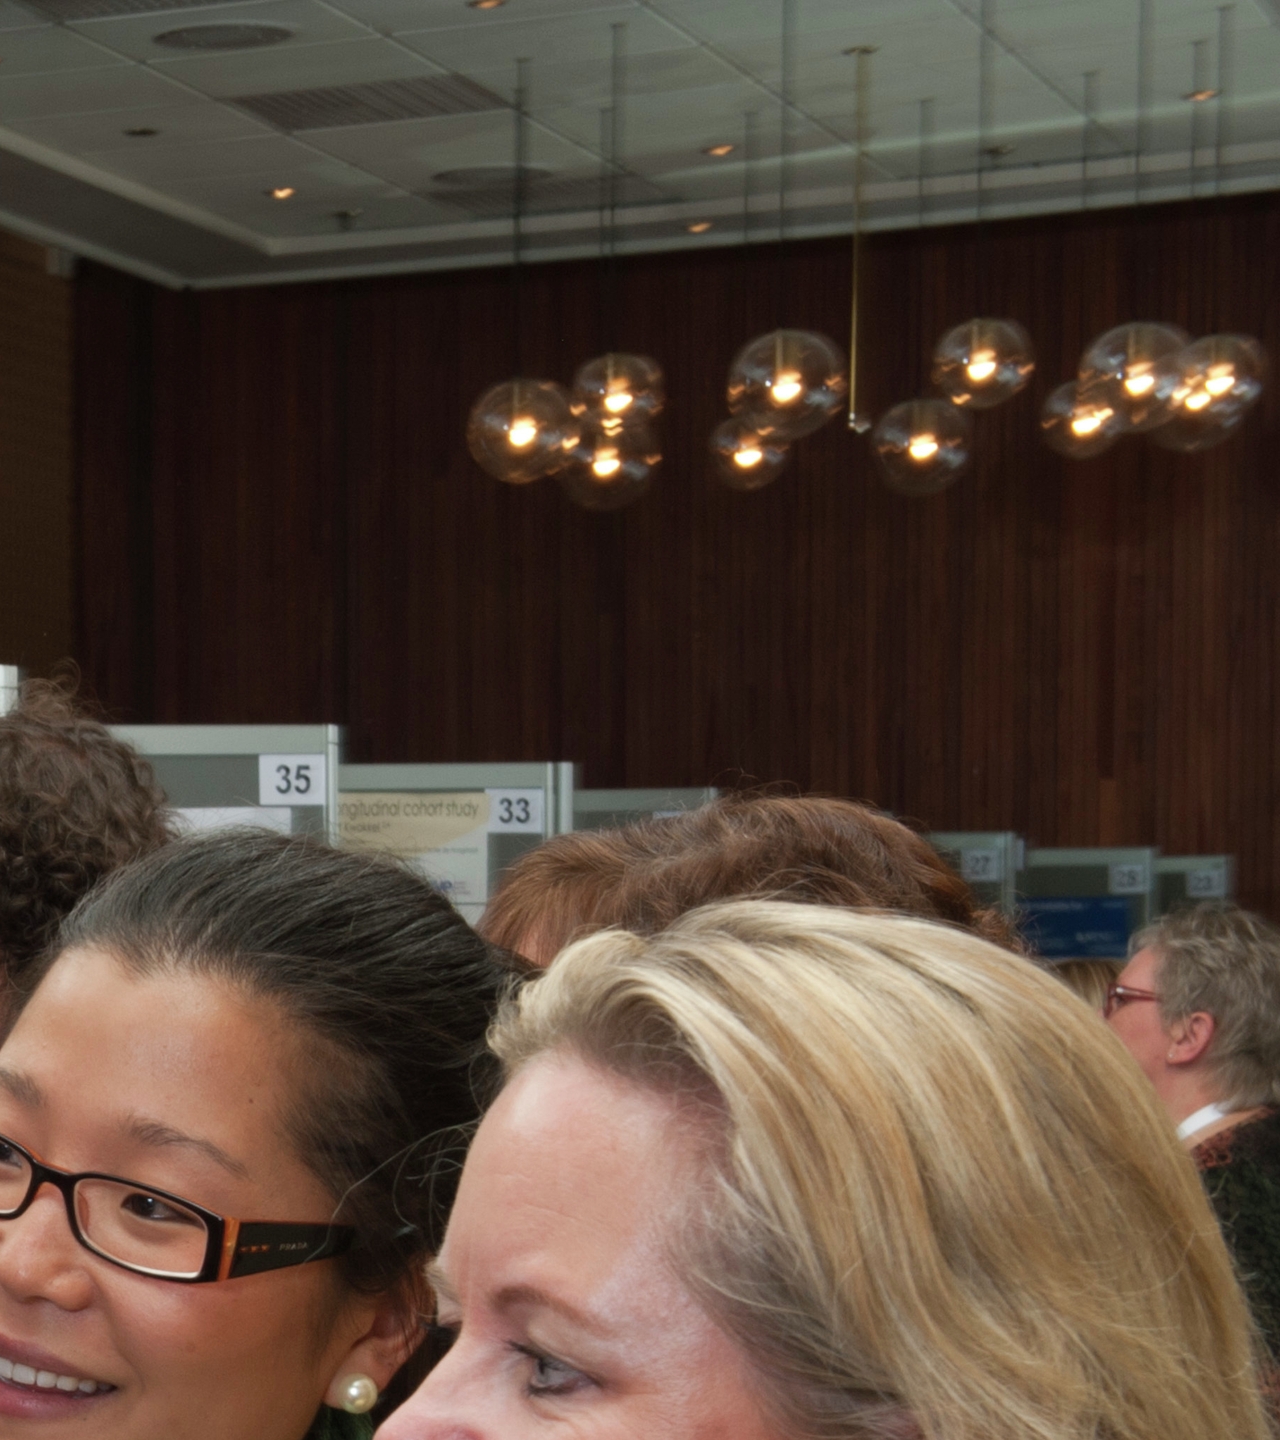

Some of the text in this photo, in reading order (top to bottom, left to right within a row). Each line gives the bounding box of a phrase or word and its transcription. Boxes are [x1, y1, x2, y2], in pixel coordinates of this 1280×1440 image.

[275, 764, 312, 794] 35
[403, 798, 444, 817] cohort
[446, 799, 480, 820] study
[497, 797, 531, 824] 33
[279, 1242, 308, 1252] PRADA
